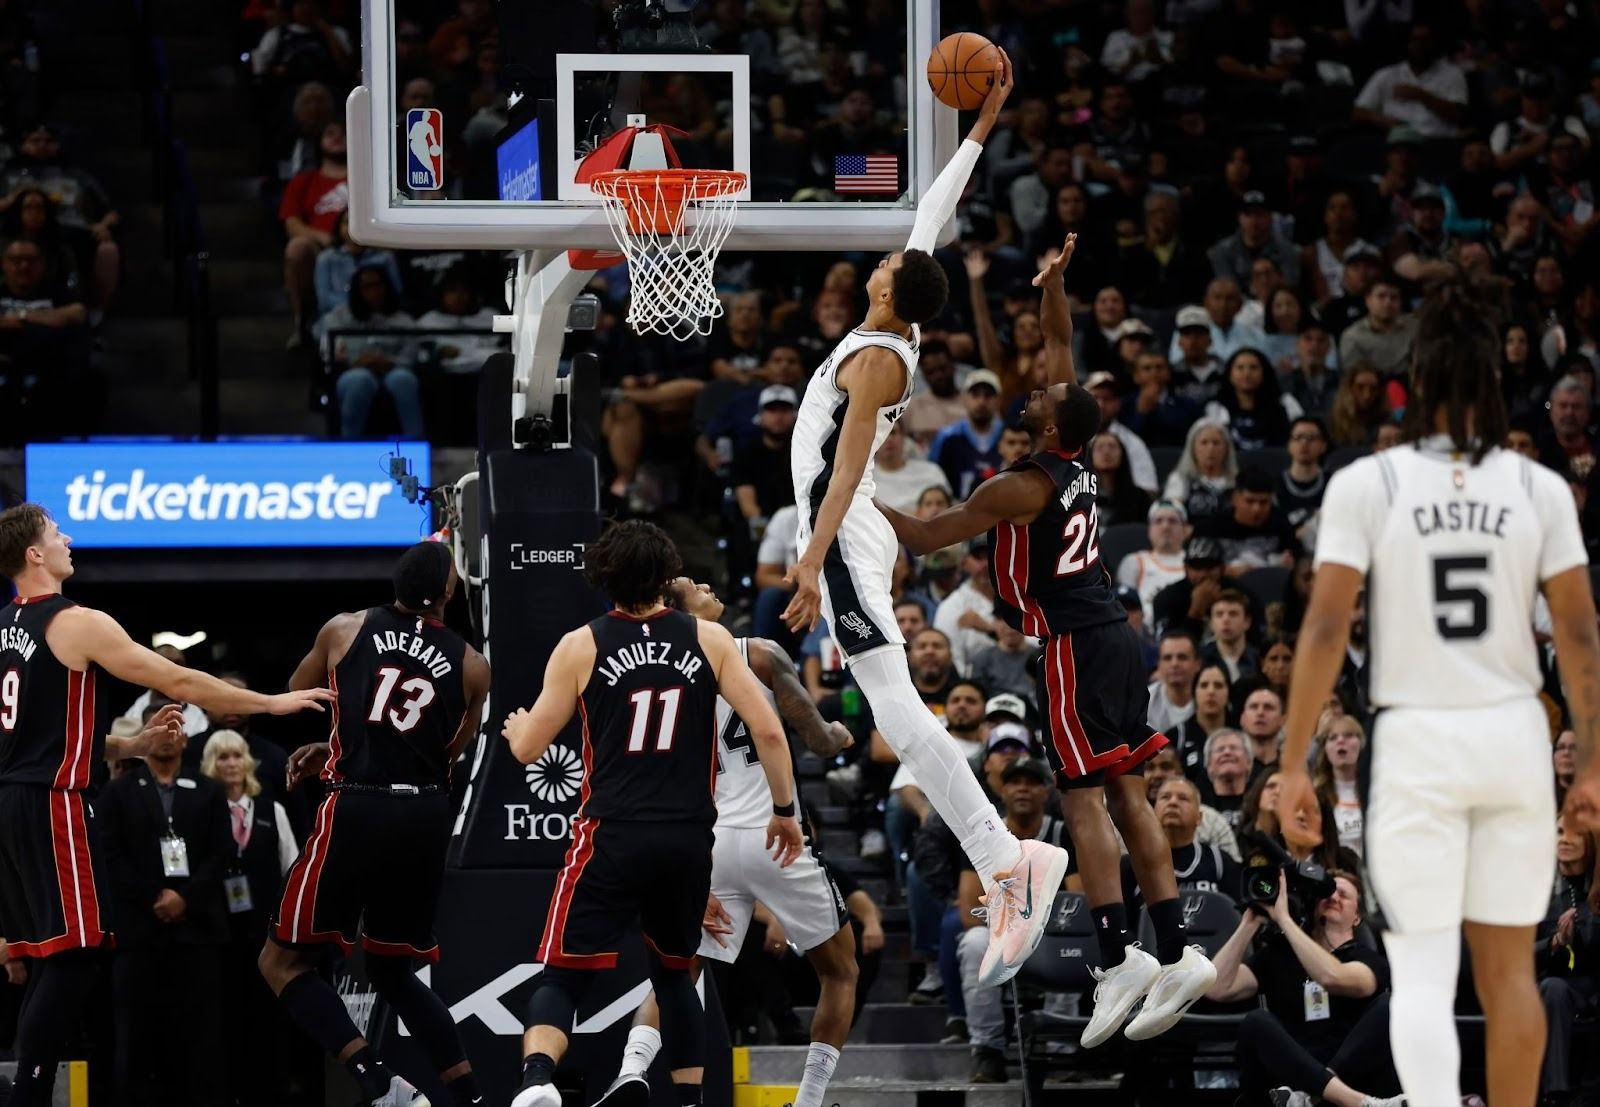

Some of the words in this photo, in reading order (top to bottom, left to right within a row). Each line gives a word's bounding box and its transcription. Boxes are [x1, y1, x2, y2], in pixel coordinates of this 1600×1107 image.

[411, 171, 430, 185] NBA
[65, 468, 393, 521] ticketmaster
[1060, 471, 1097, 512] WIGGINS
[1056, 502, 1099, 576] 22
[1413, 501, 1513, 539] CASTLE
[520, 550, 575, 563] LEDGER
[1432, 555, 1490, 640] 5
[0, 626, 37, 662] RSSON
[372, 630, 452, 679] ADEBAYO
[598, 642, 672, 687] JAQUEZ
[673, 650, 702, 684] JR.
[367, 666, 436, 733] 13
[627, 687, 682, 753] 11
